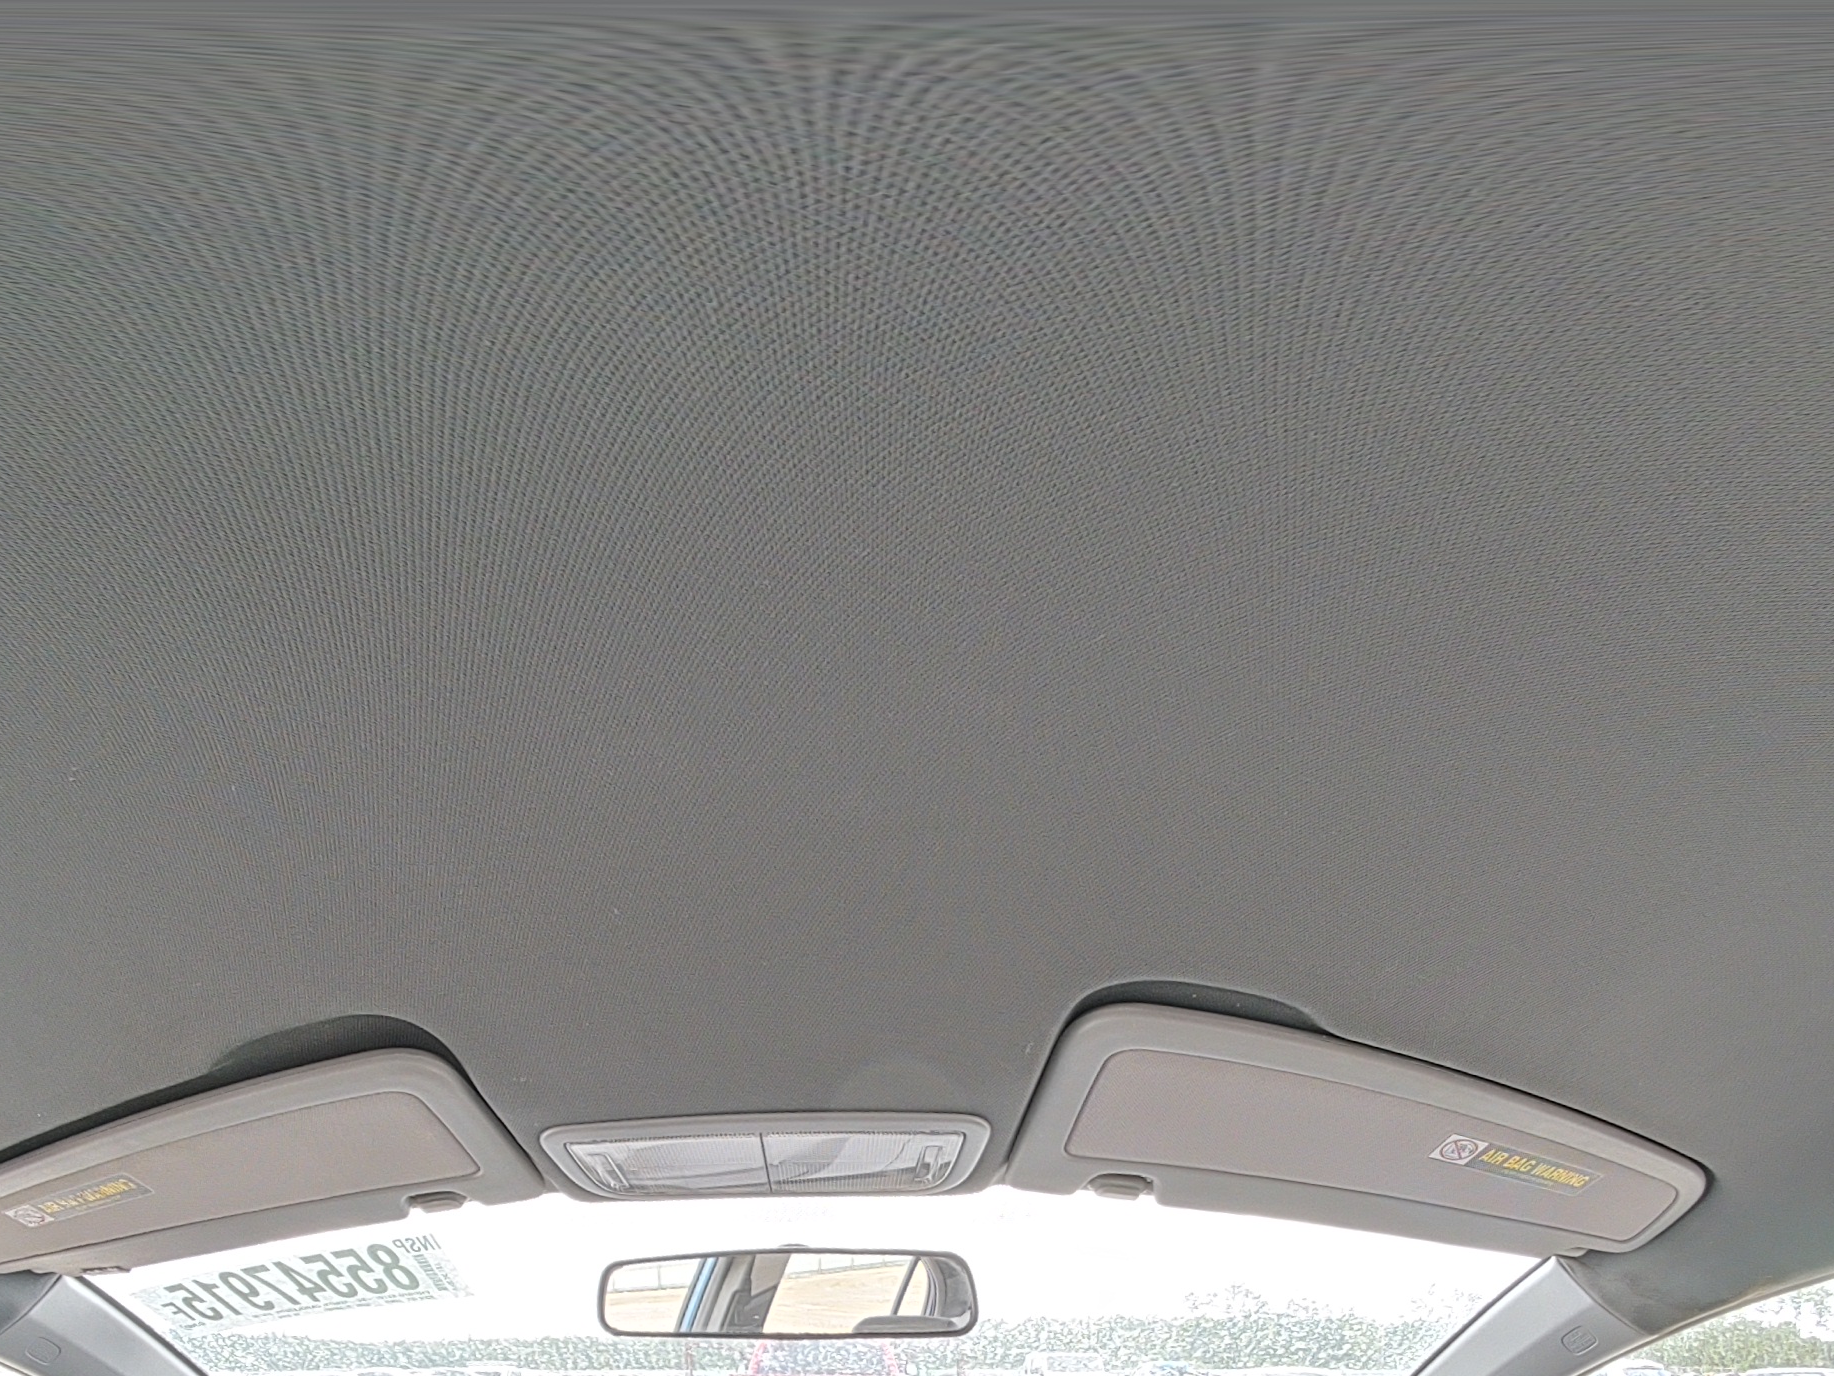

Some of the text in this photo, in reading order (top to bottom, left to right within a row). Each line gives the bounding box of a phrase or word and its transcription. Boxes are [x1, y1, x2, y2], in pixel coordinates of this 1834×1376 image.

[1479, 1149, 1506, 1165] AIR
[1503, 1155, 1537, 1173] BAG
[1531, 1163, 1590, 1188] WARNING
